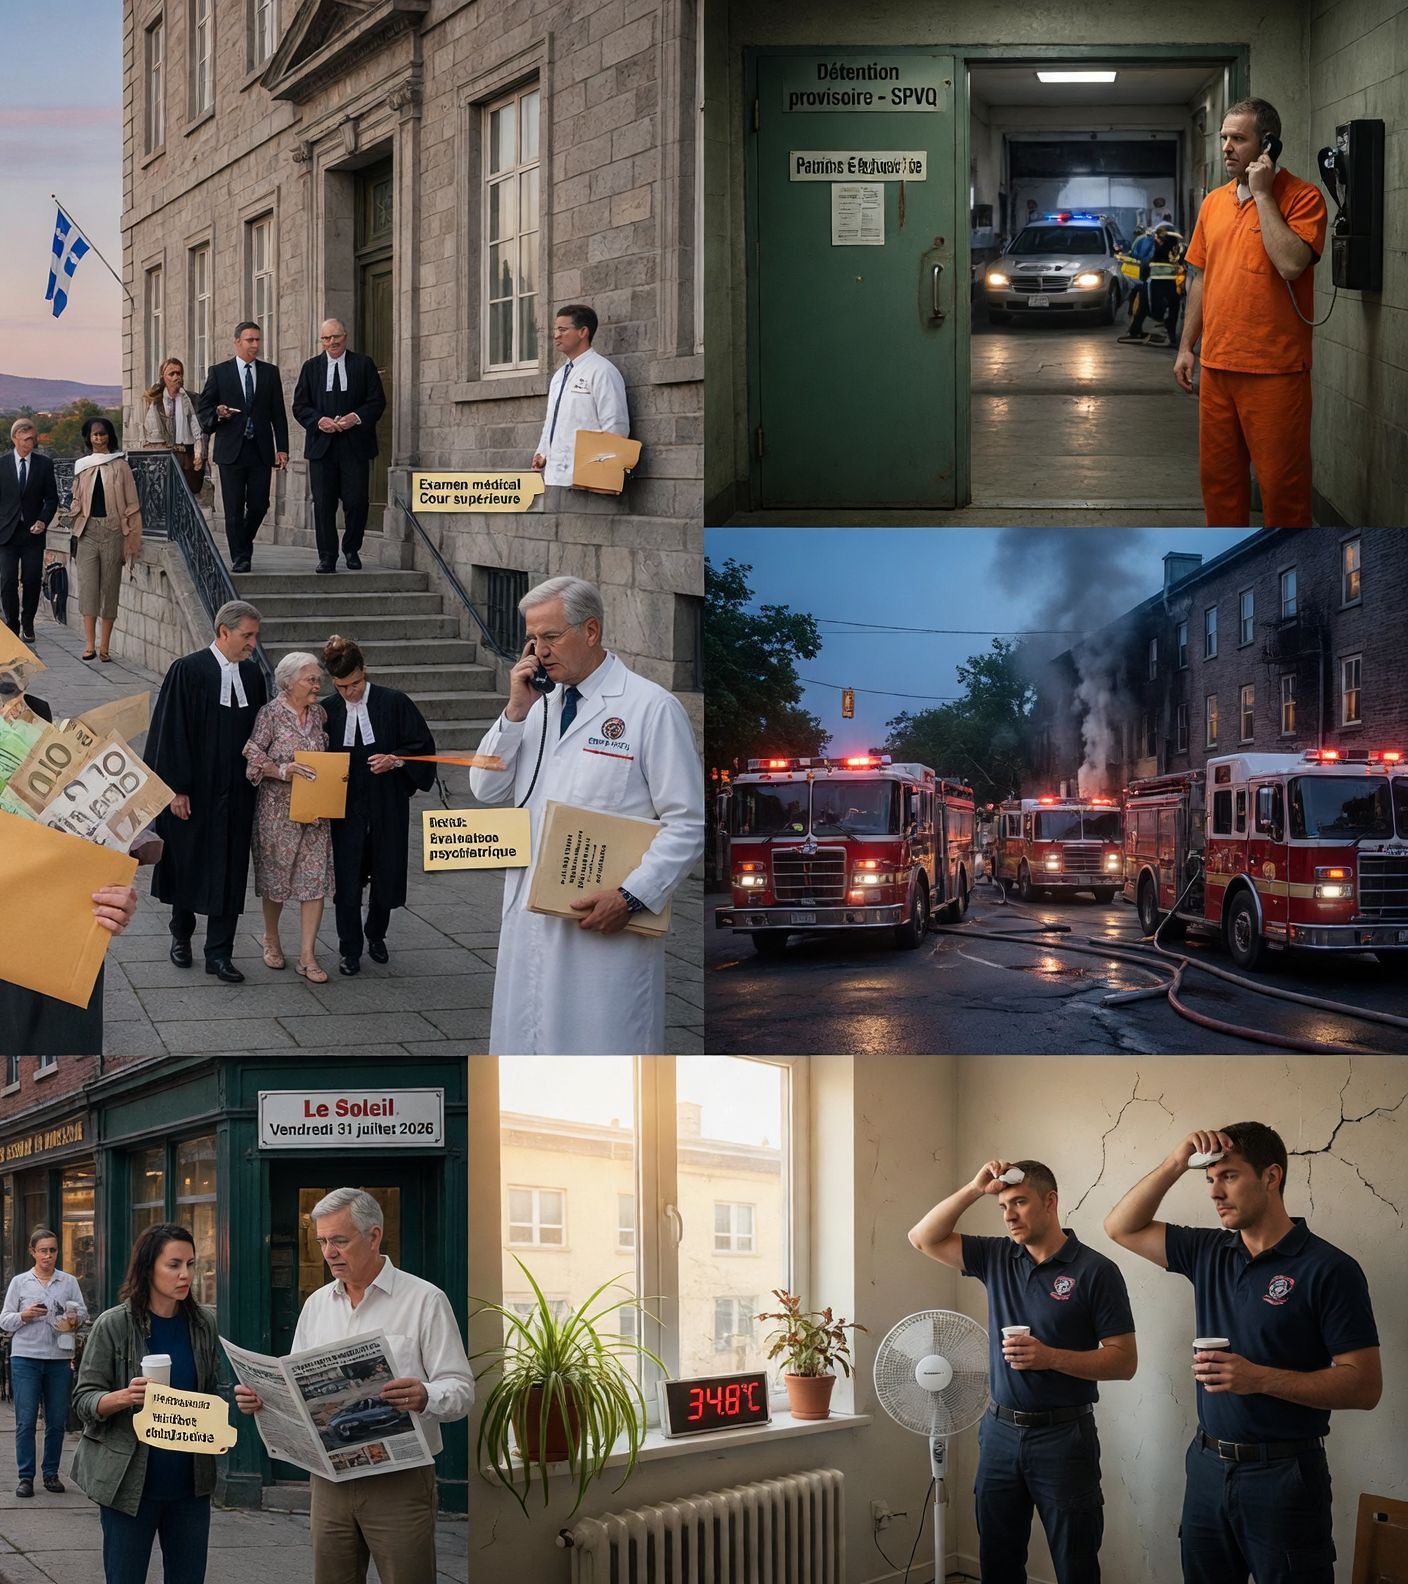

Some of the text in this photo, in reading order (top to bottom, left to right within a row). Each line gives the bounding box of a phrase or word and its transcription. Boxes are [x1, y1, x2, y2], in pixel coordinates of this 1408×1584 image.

[817, 62, 900, 80] Détention
[789, 88, 873, 110] provisoire
[891, 87, 937, 107] SPVQ
[419, 478, 521, 490] Examen médical
[420, 492, 451, 504] Cour
[303, 1098, 395, 1118] Le Soleil
[269, 1123, 333, 1136] Vendredi
[337, 1123, 352, 1135] 31
[399, 1122, 434, 1135] 2026
